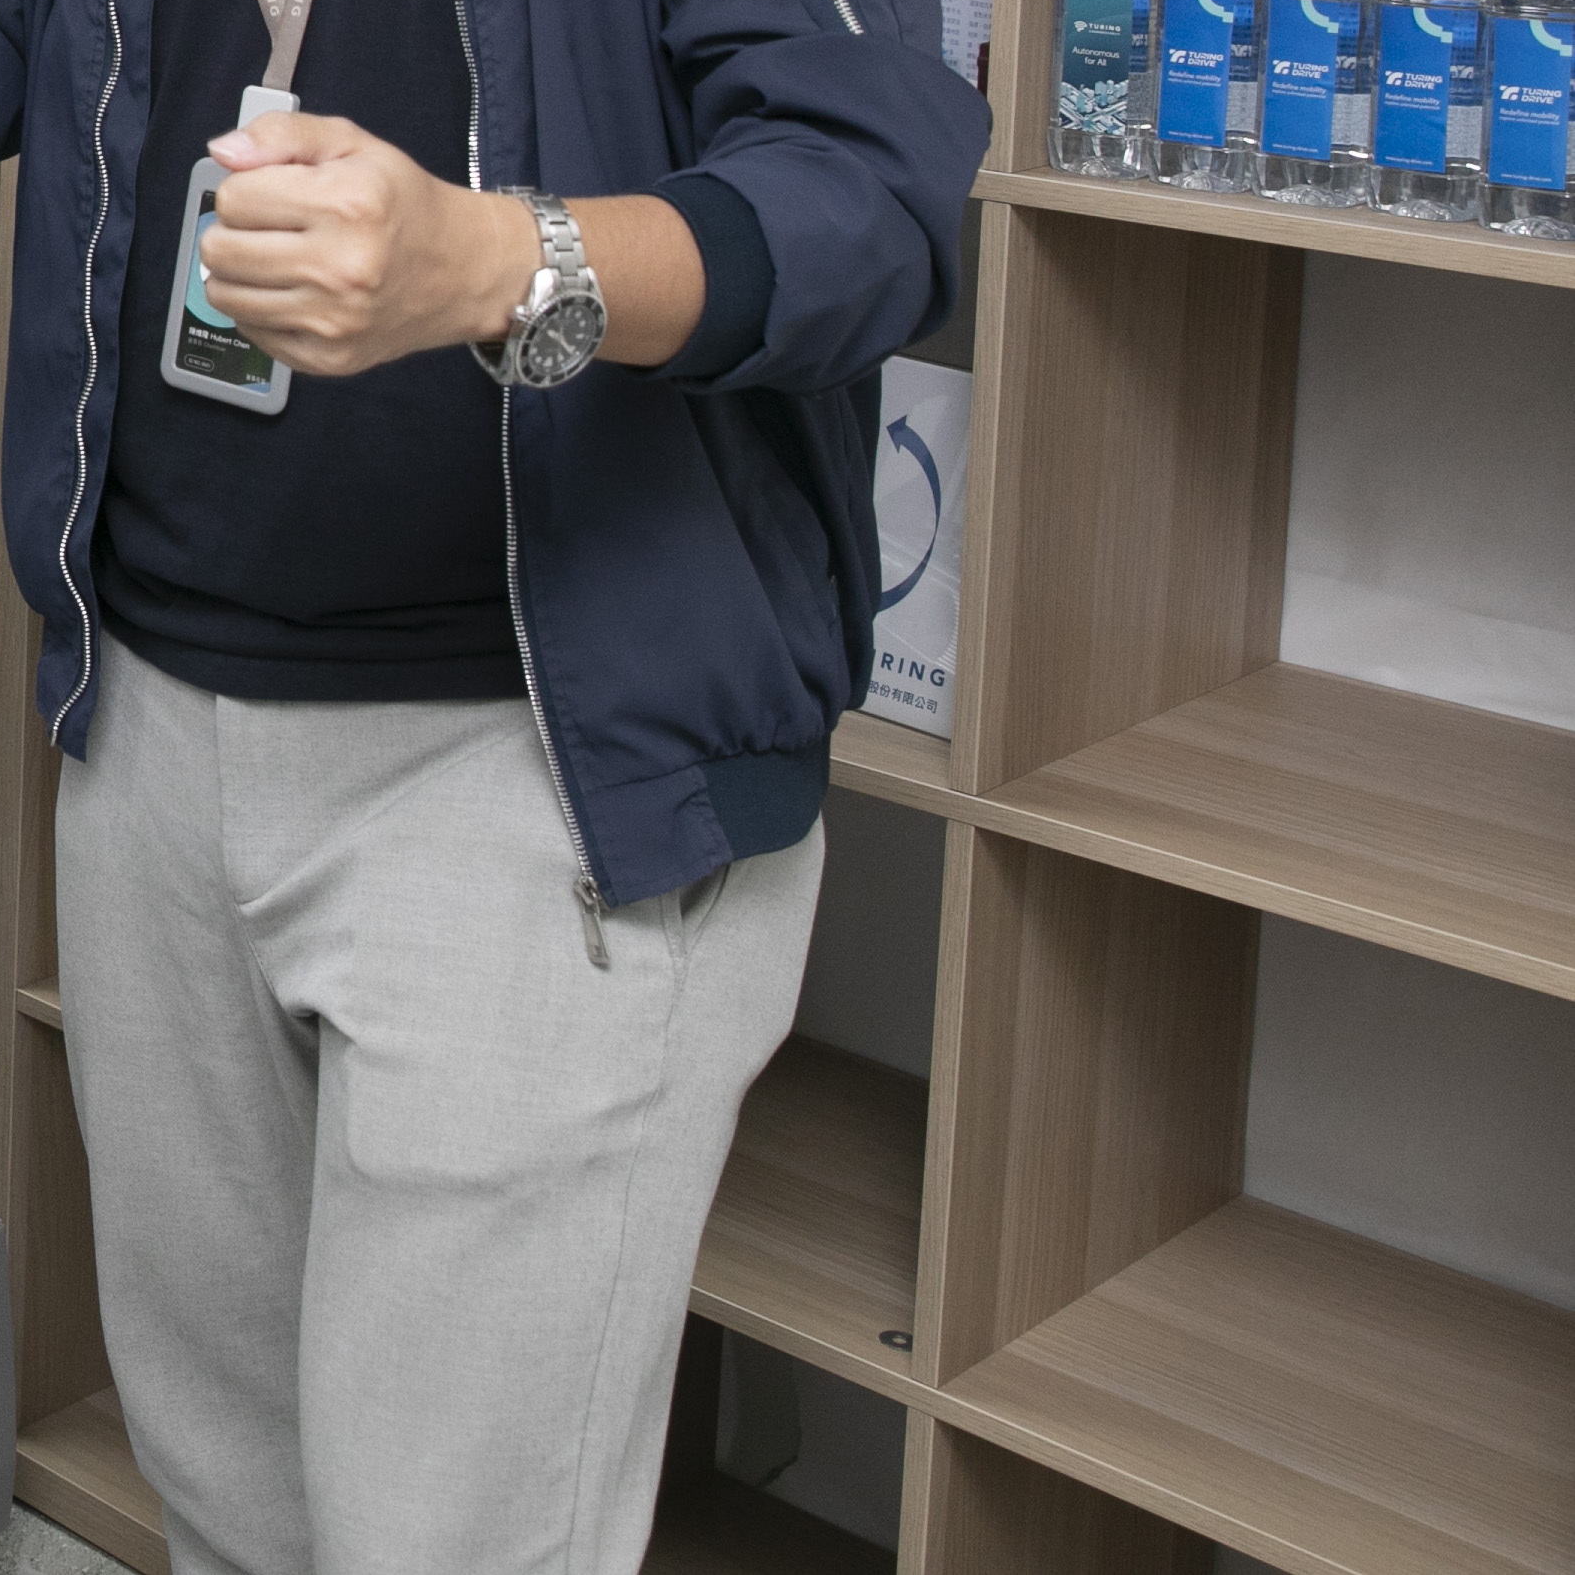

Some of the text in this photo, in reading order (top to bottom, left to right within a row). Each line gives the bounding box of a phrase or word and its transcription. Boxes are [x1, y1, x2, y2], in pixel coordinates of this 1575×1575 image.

[1088, 23, 1121, 32] TURING
[1072, 46, 1120, 59] Autonomous
[1188, 51, 1224, 61] TURING
[1084, 57, 1107, 66] for All
[1187, 59, 1217, 67] DRIVE
[1292, 62, 1329, 73] TURING
[1291, 70, 1322, 79] DRIVE
[1405, 72, 1443, 84] TURING
[1404, 80, 1435, 90] DRIVE
[1522, 87, 1562, 98] TURING
[1521, 95, 1554, 104] DRIVE
[868, 680, 938, 714] 股份有限公司
